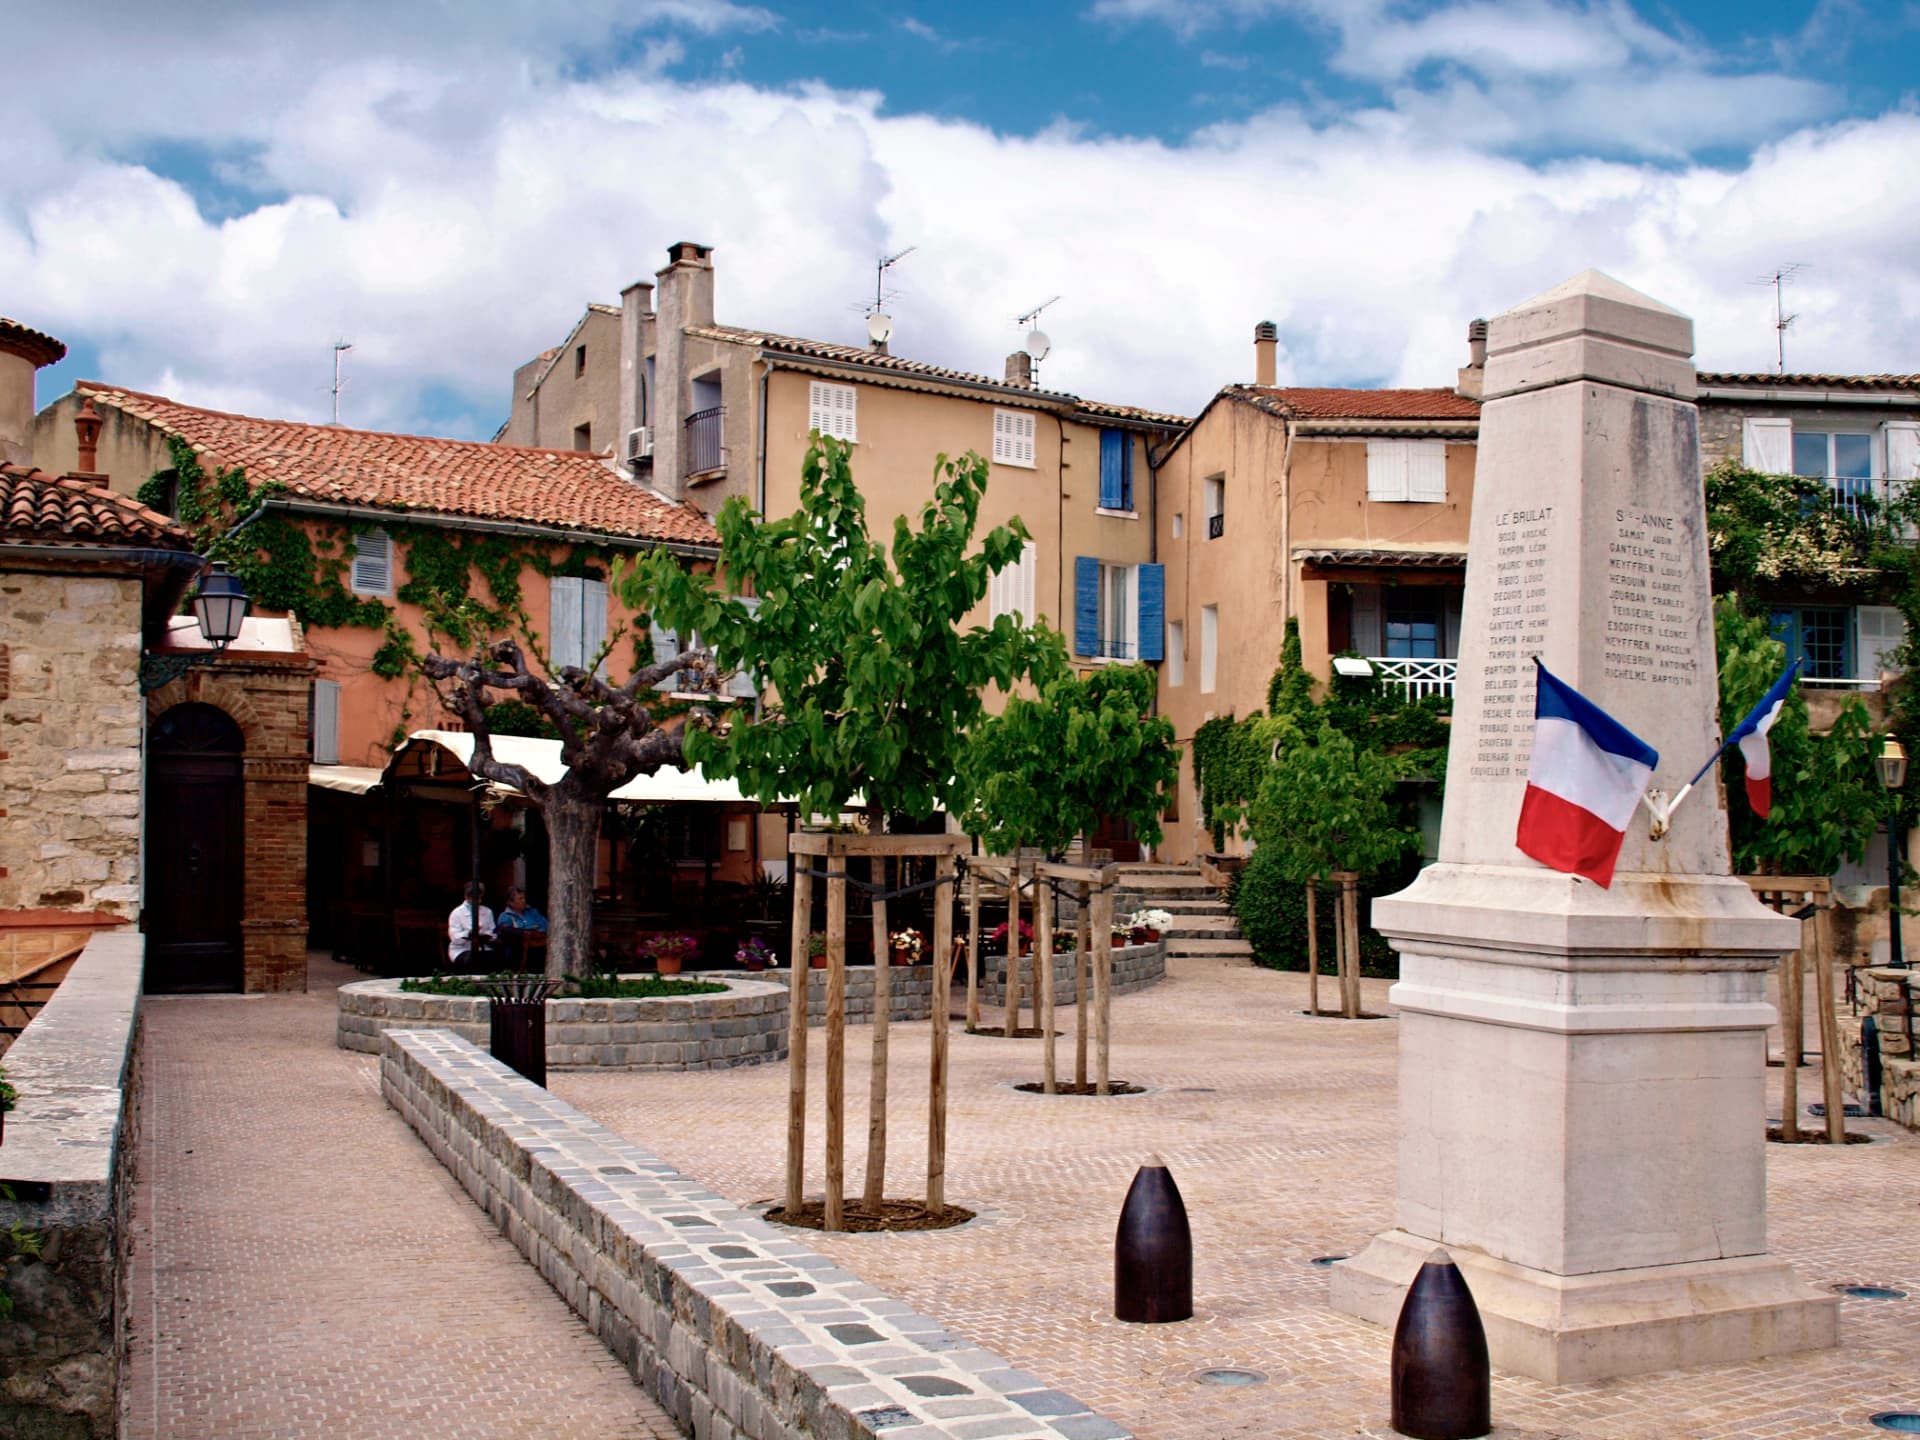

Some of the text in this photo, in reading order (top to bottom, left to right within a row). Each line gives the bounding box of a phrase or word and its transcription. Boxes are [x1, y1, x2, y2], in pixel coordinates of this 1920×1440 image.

[1496, 508, 1552, 526] LE BRULAT
[1619, 528, 1645, 542] SAMAT
